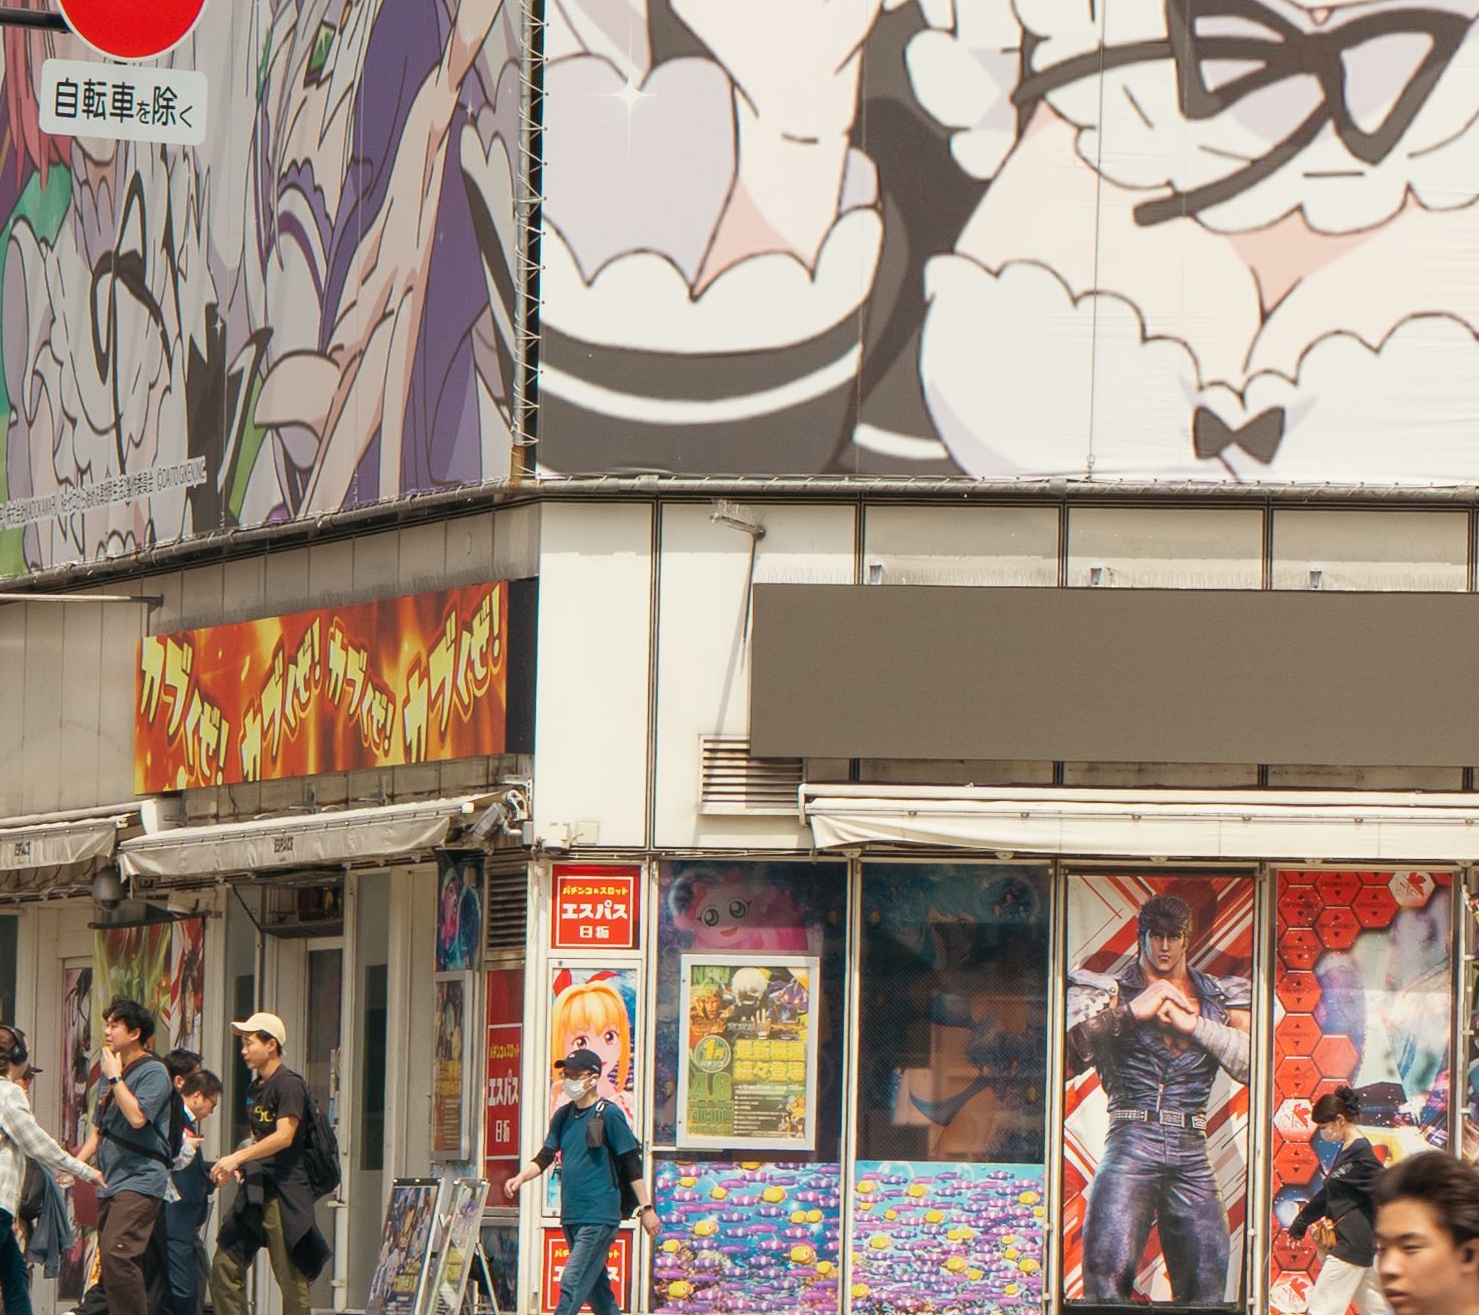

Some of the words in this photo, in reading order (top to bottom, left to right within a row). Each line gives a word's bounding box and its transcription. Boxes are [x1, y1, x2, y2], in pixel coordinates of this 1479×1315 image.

[53, 79, 194, 130] 自転車を除く
[561, 899, 629, 920] エスパス
[488, 1069, 520, 1107] エスパス
